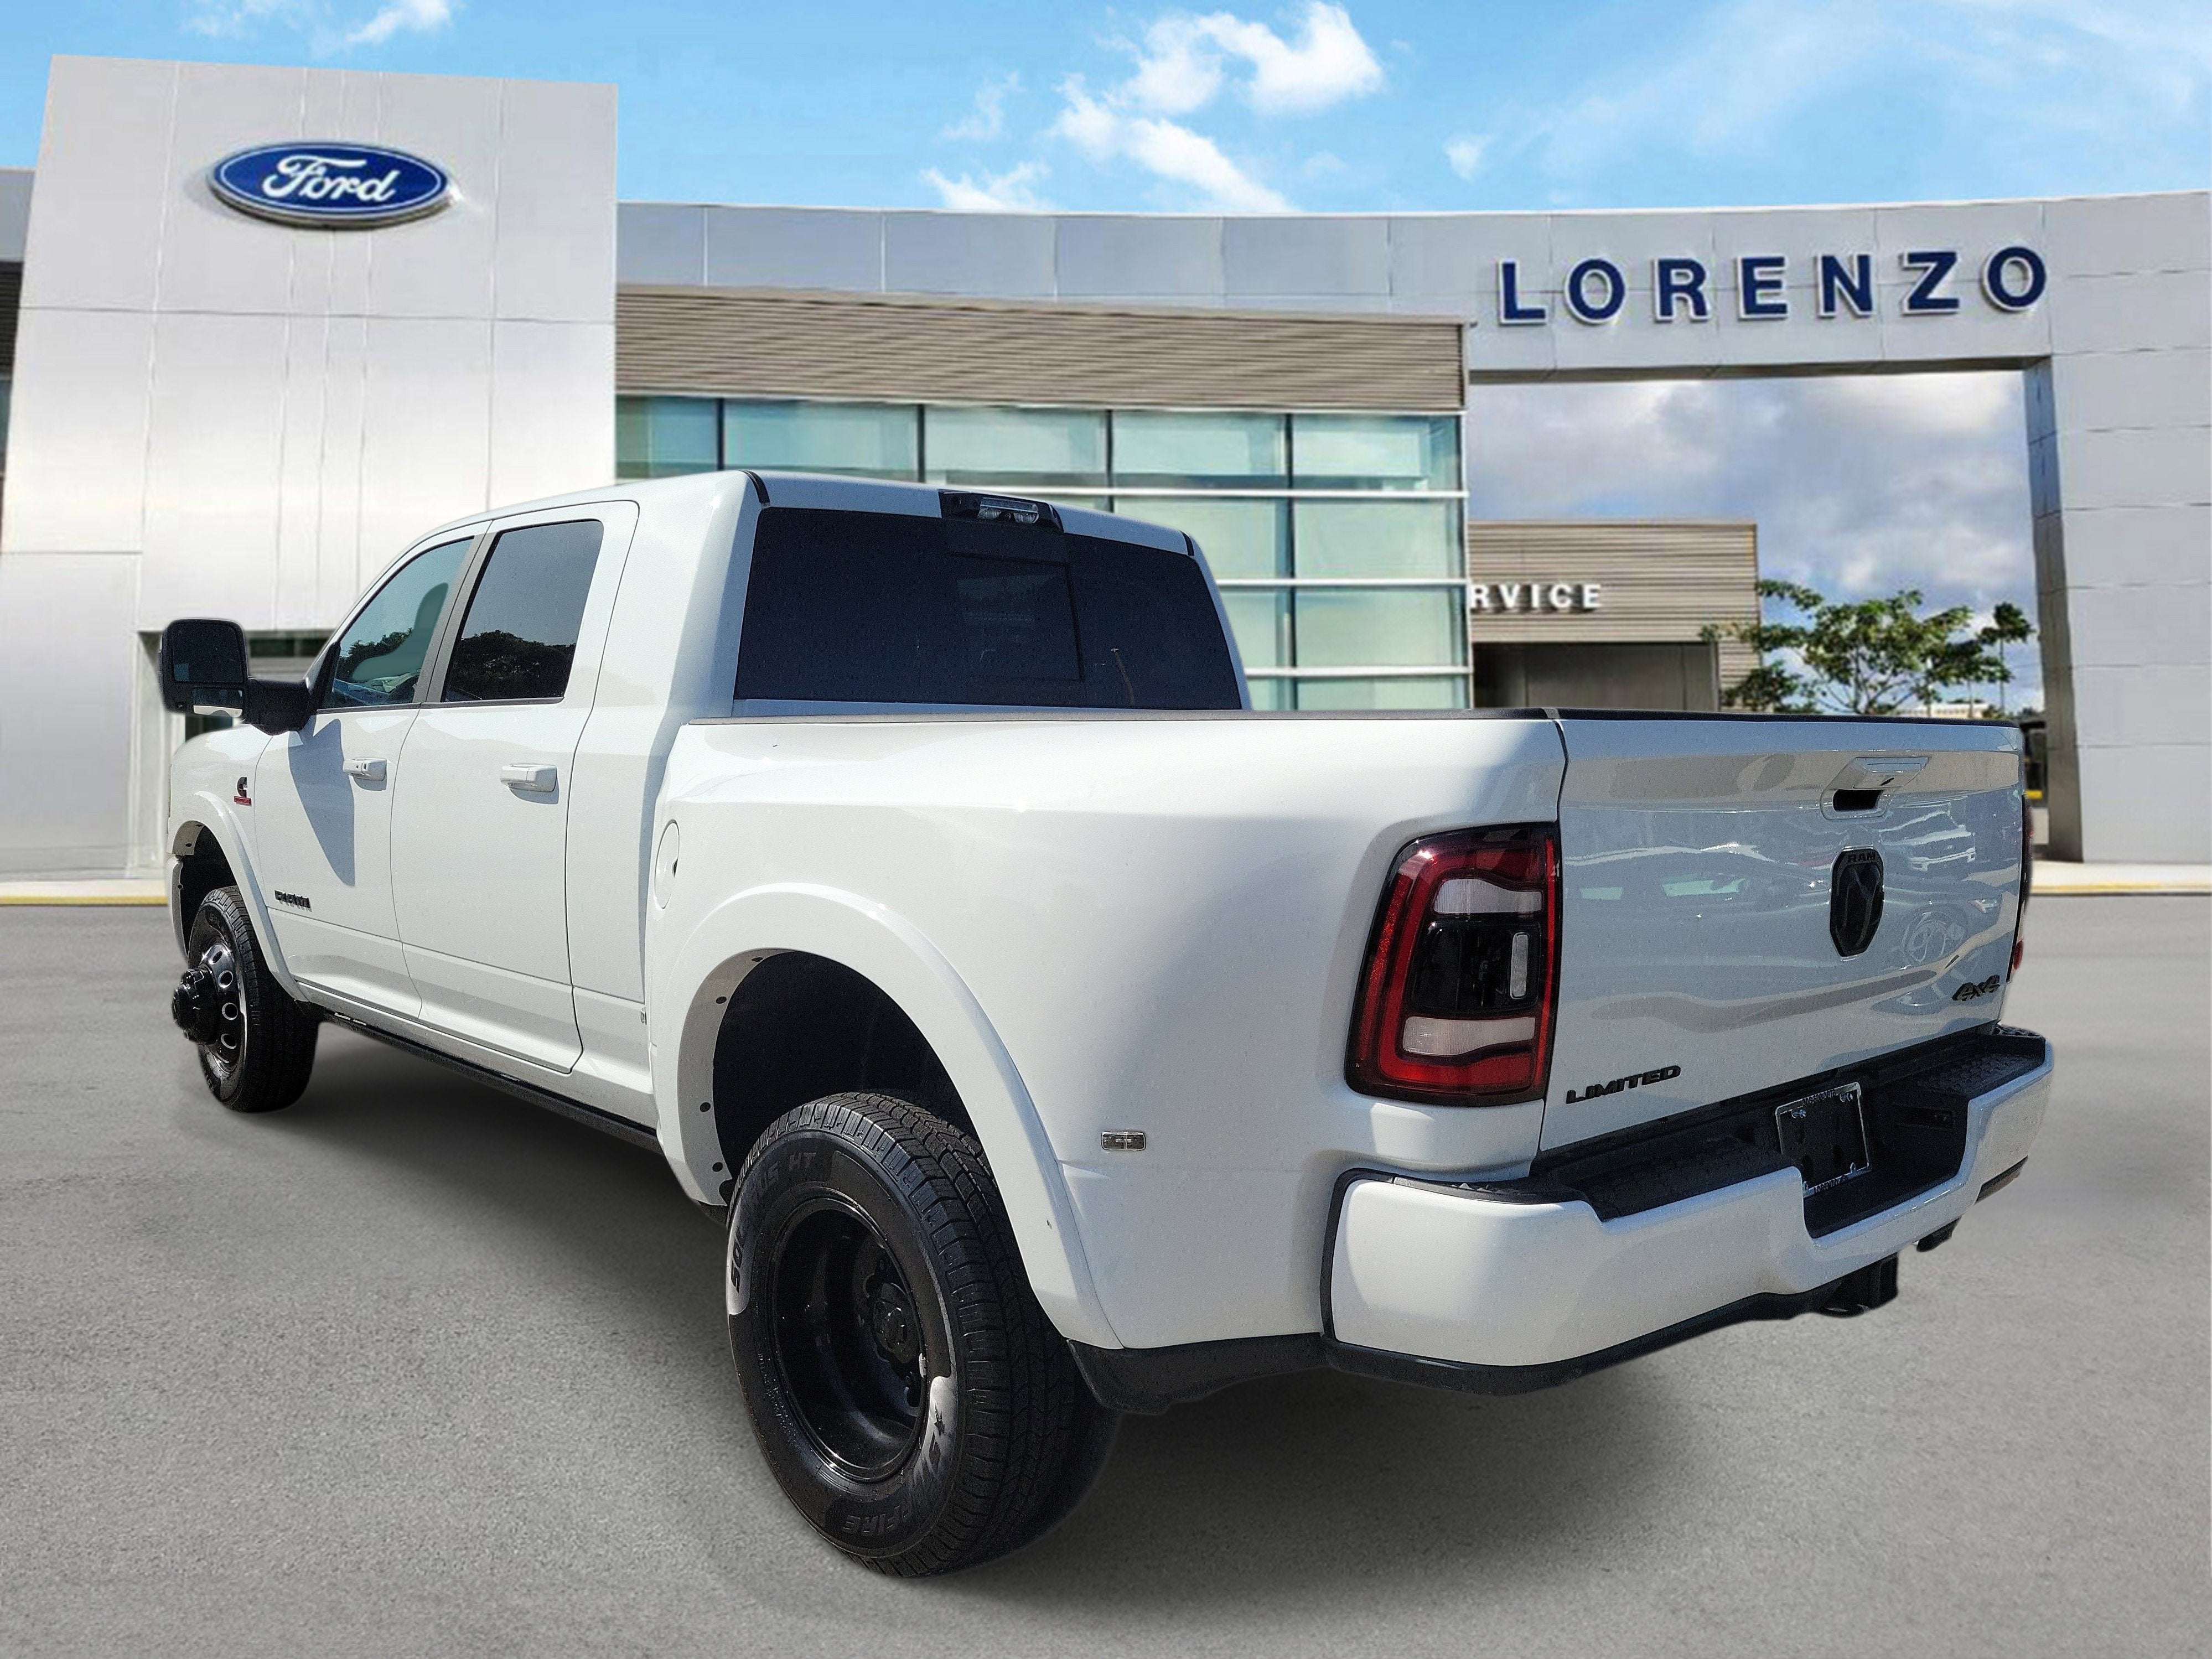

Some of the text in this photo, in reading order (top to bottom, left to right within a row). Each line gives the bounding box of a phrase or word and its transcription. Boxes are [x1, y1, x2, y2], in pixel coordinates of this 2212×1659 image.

[262, 155, 401, 202] Ford
[1497, 246, 2047, 325] LORENZO
[1470, 584, 1602, 608] RVICE
[1848, 852, 1876, 863] RAM
[1566, 1065, 1681, 1104] LIMITED
[789, 1152, 817, 1171] HT
